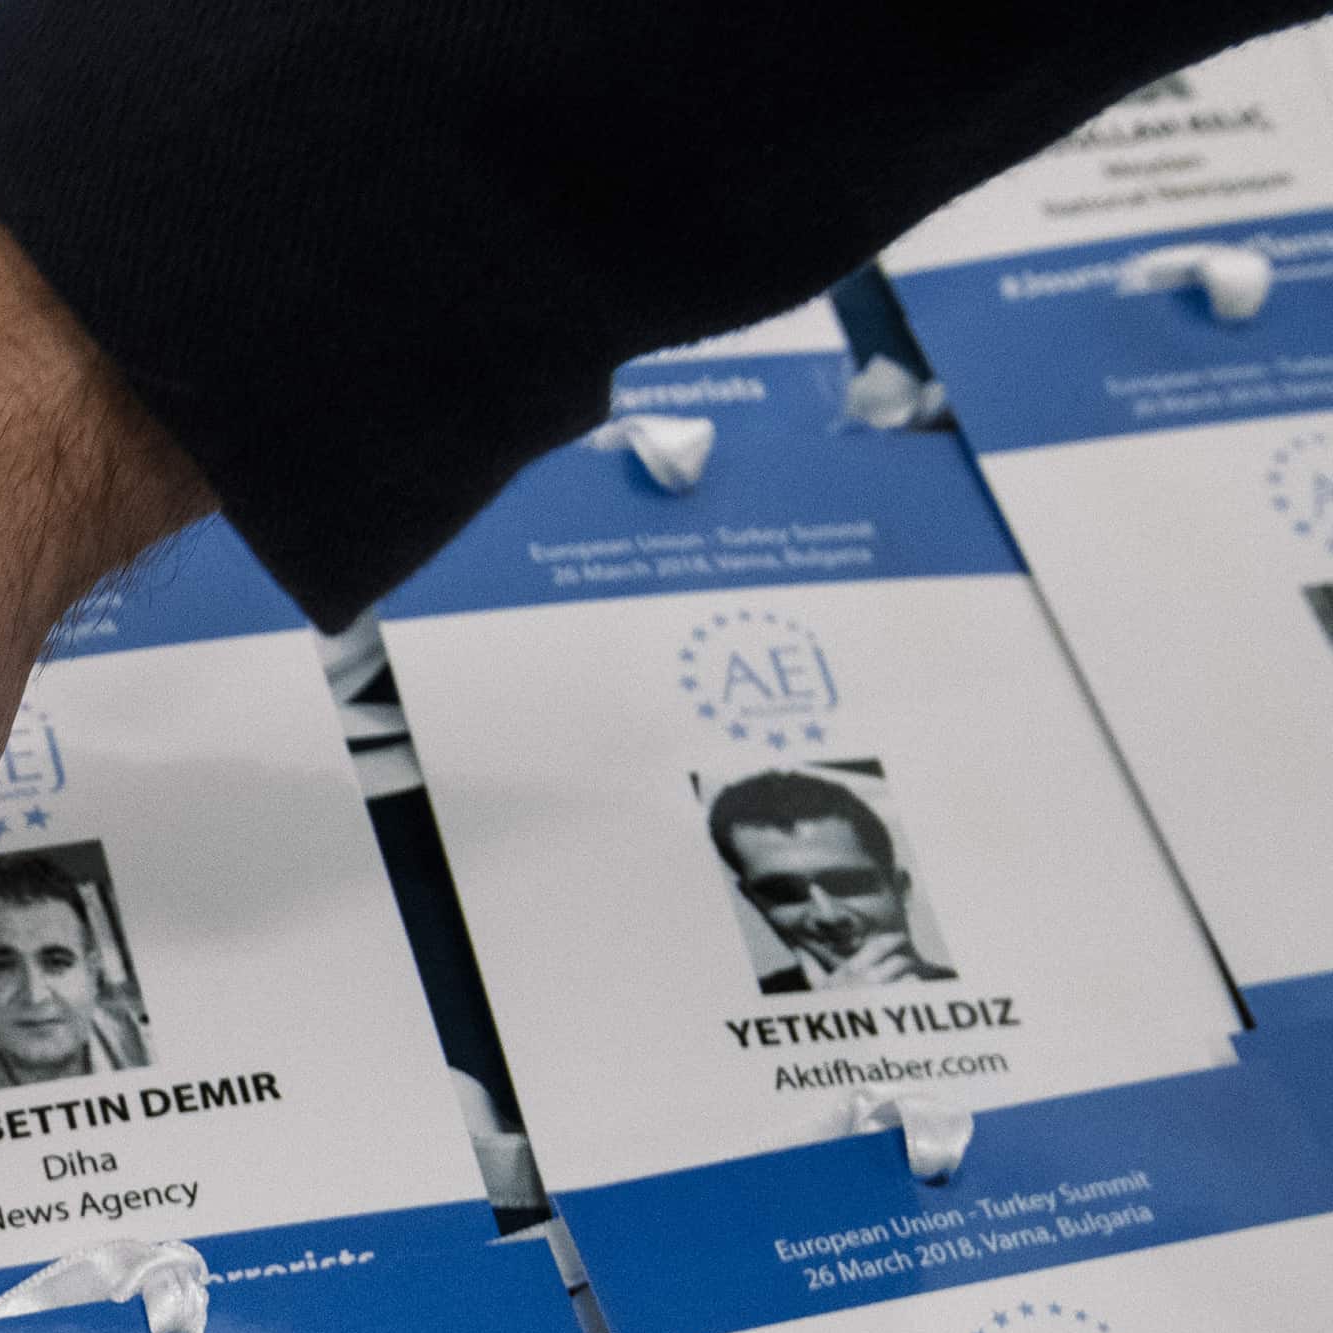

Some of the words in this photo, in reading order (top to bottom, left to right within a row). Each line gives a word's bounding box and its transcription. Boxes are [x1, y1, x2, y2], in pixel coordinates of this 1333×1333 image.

[729, 1010, 877, 1053] YETKIN
[884, 998, 1018, 1033] YILDIZ
[139, 1072, 281, 1118] DEMIR
[776, 1054, 1007, 1090] Aktifhaber.com
[43, 1151, 117, 1180] Diha
[80, 1182, 198, 1219] Agency
[773, 1226, 889, 1262] European
[888, 1211, 963, 1240] Union
[978, 1193, 1054, 1220] Turkey
[1056, 1172, 1150, 1207] Summit
[802, 1263, 836, 1289] 26
[836, 1248, 914, 1282] March
[913, 1235, 982, 1266] 2018,
[983, 1225, 1057, 1249] Varna,
[1056, 1203, 1153, 1237] Bulgaria
